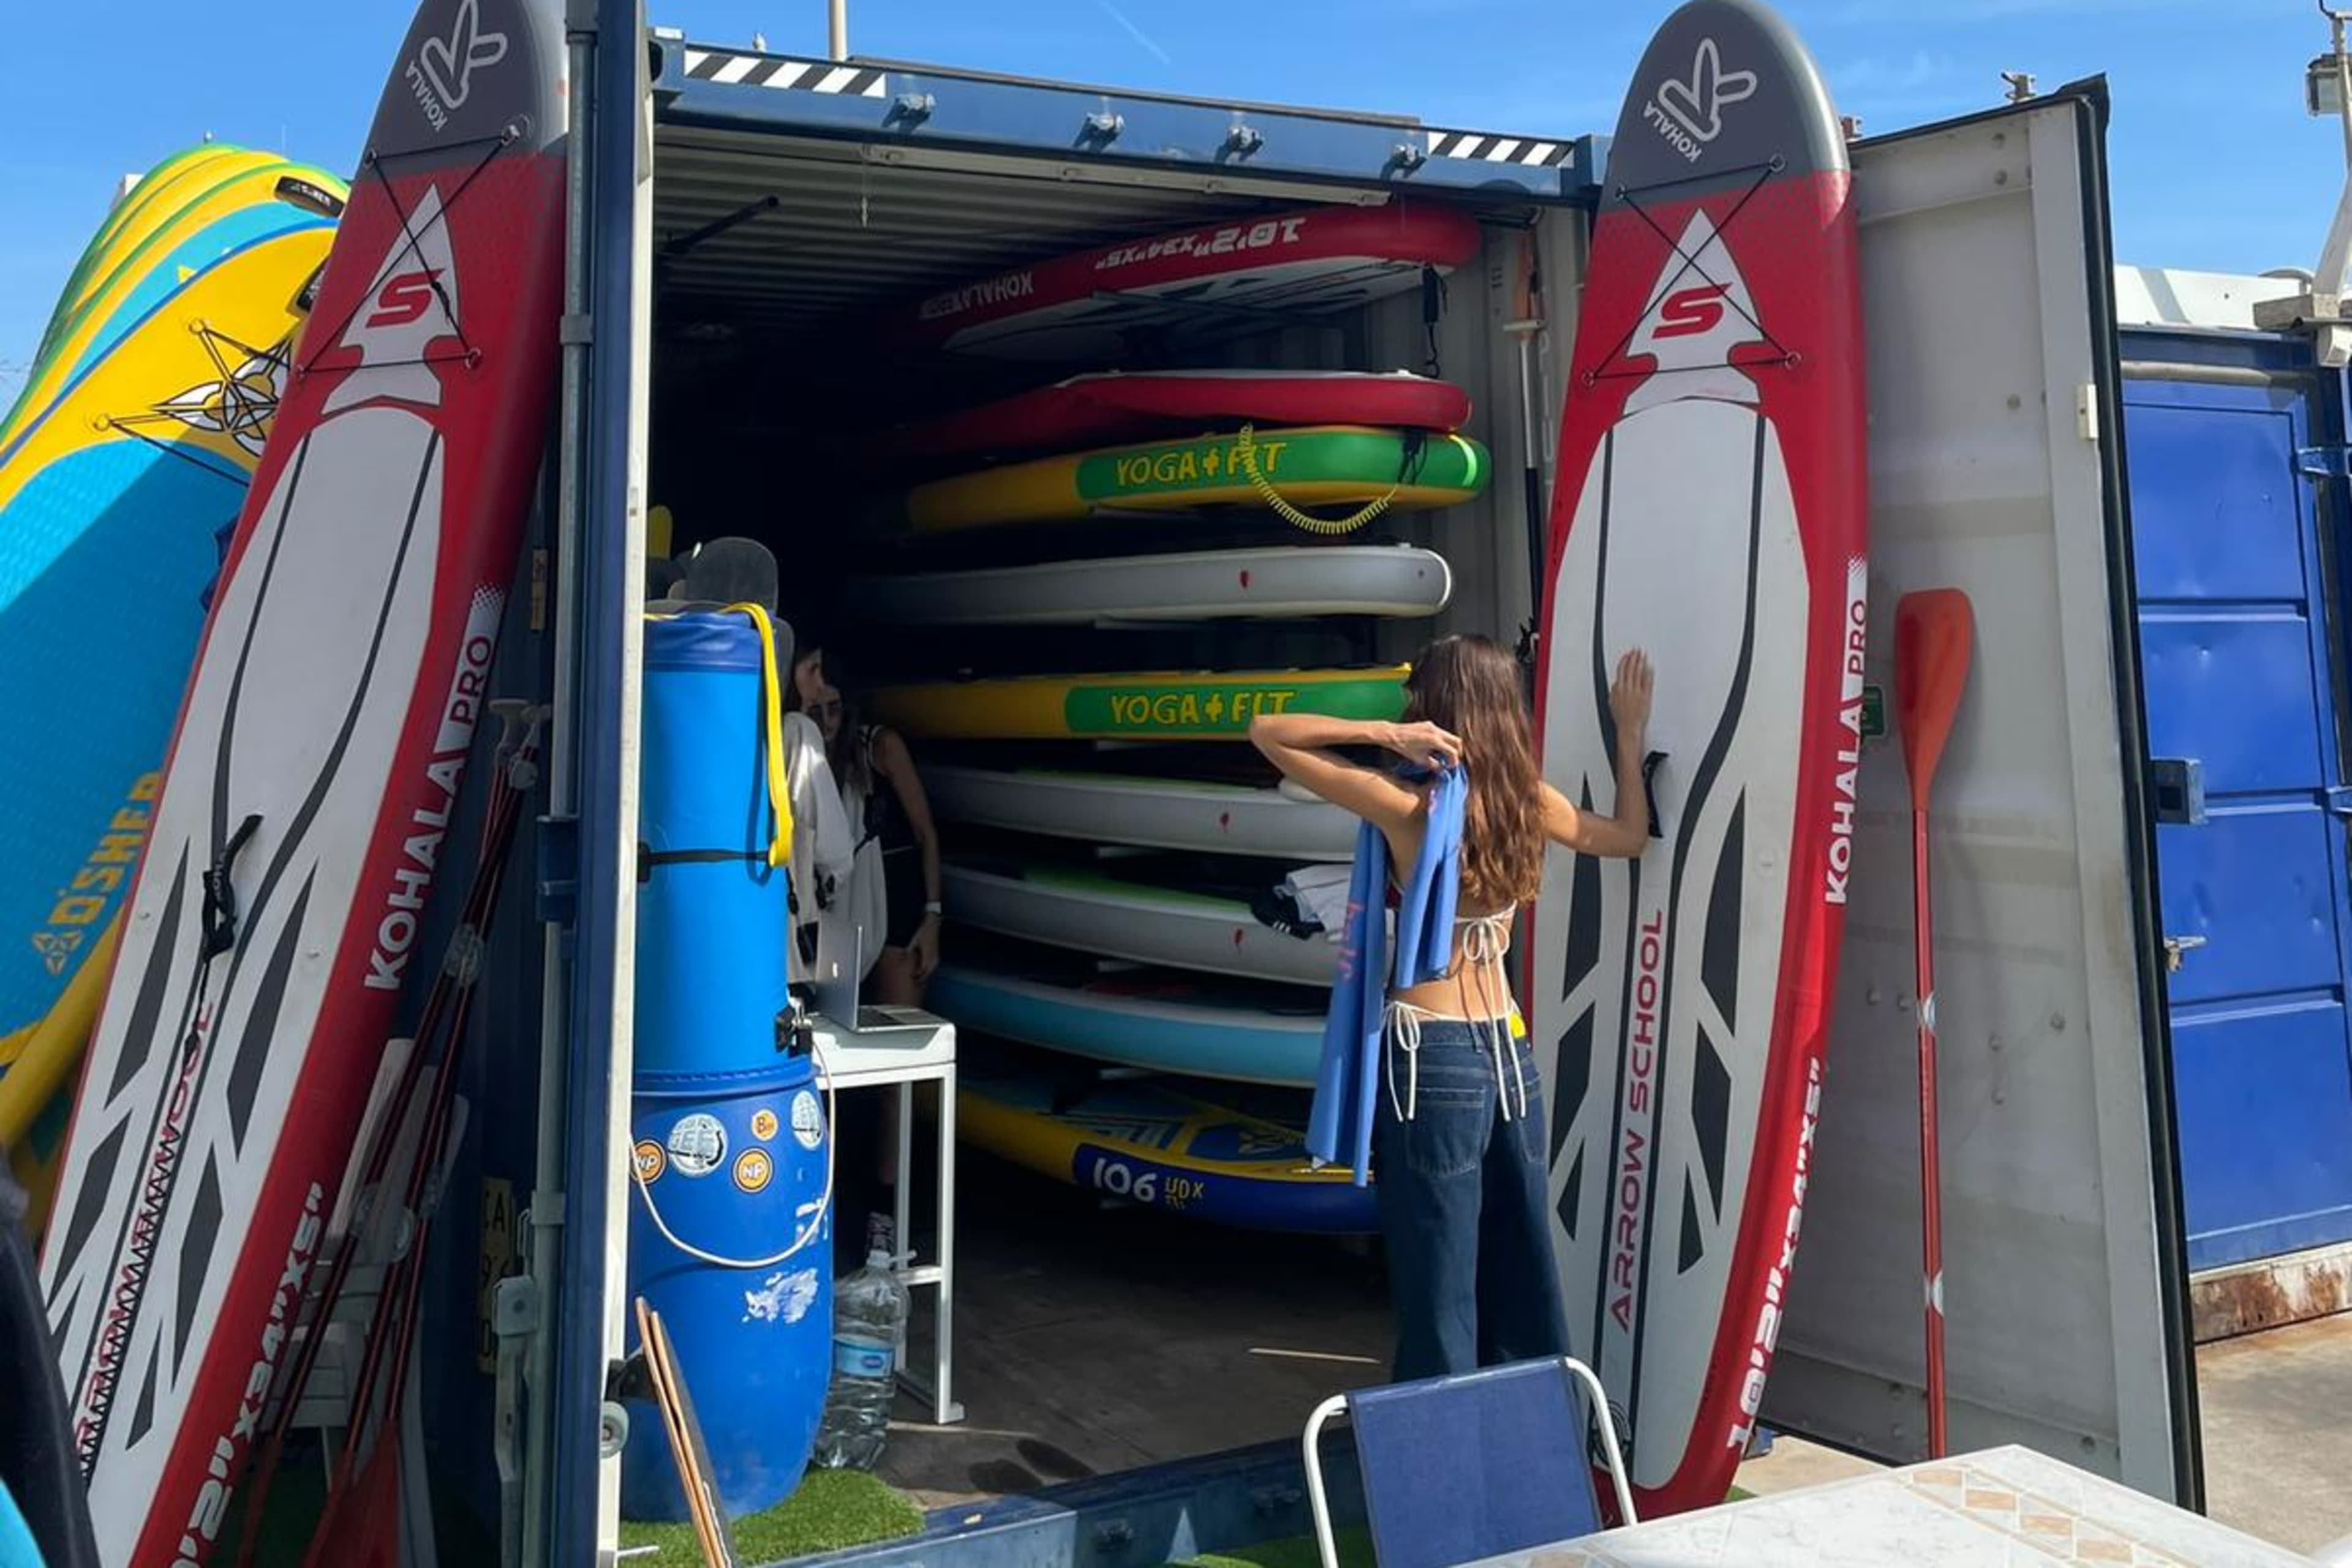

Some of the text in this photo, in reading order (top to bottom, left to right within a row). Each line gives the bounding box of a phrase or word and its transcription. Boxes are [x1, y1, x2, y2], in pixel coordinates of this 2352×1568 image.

[405, 59, 448, 132] KOHALA
[1643, 100, 1702, 163] KOHALA
[1116, 451, 1199, 486] YOGA
[1110, 694, 1201, 725] YOGA
[1232, 690, 1295, 723] FIT
[1824, 599, 1866, 905] KOHALA PRO
[363, 635, 491, 990] KOHALA PRO
[1610, 910, 1662, 1335] ARROW SCHOOL
